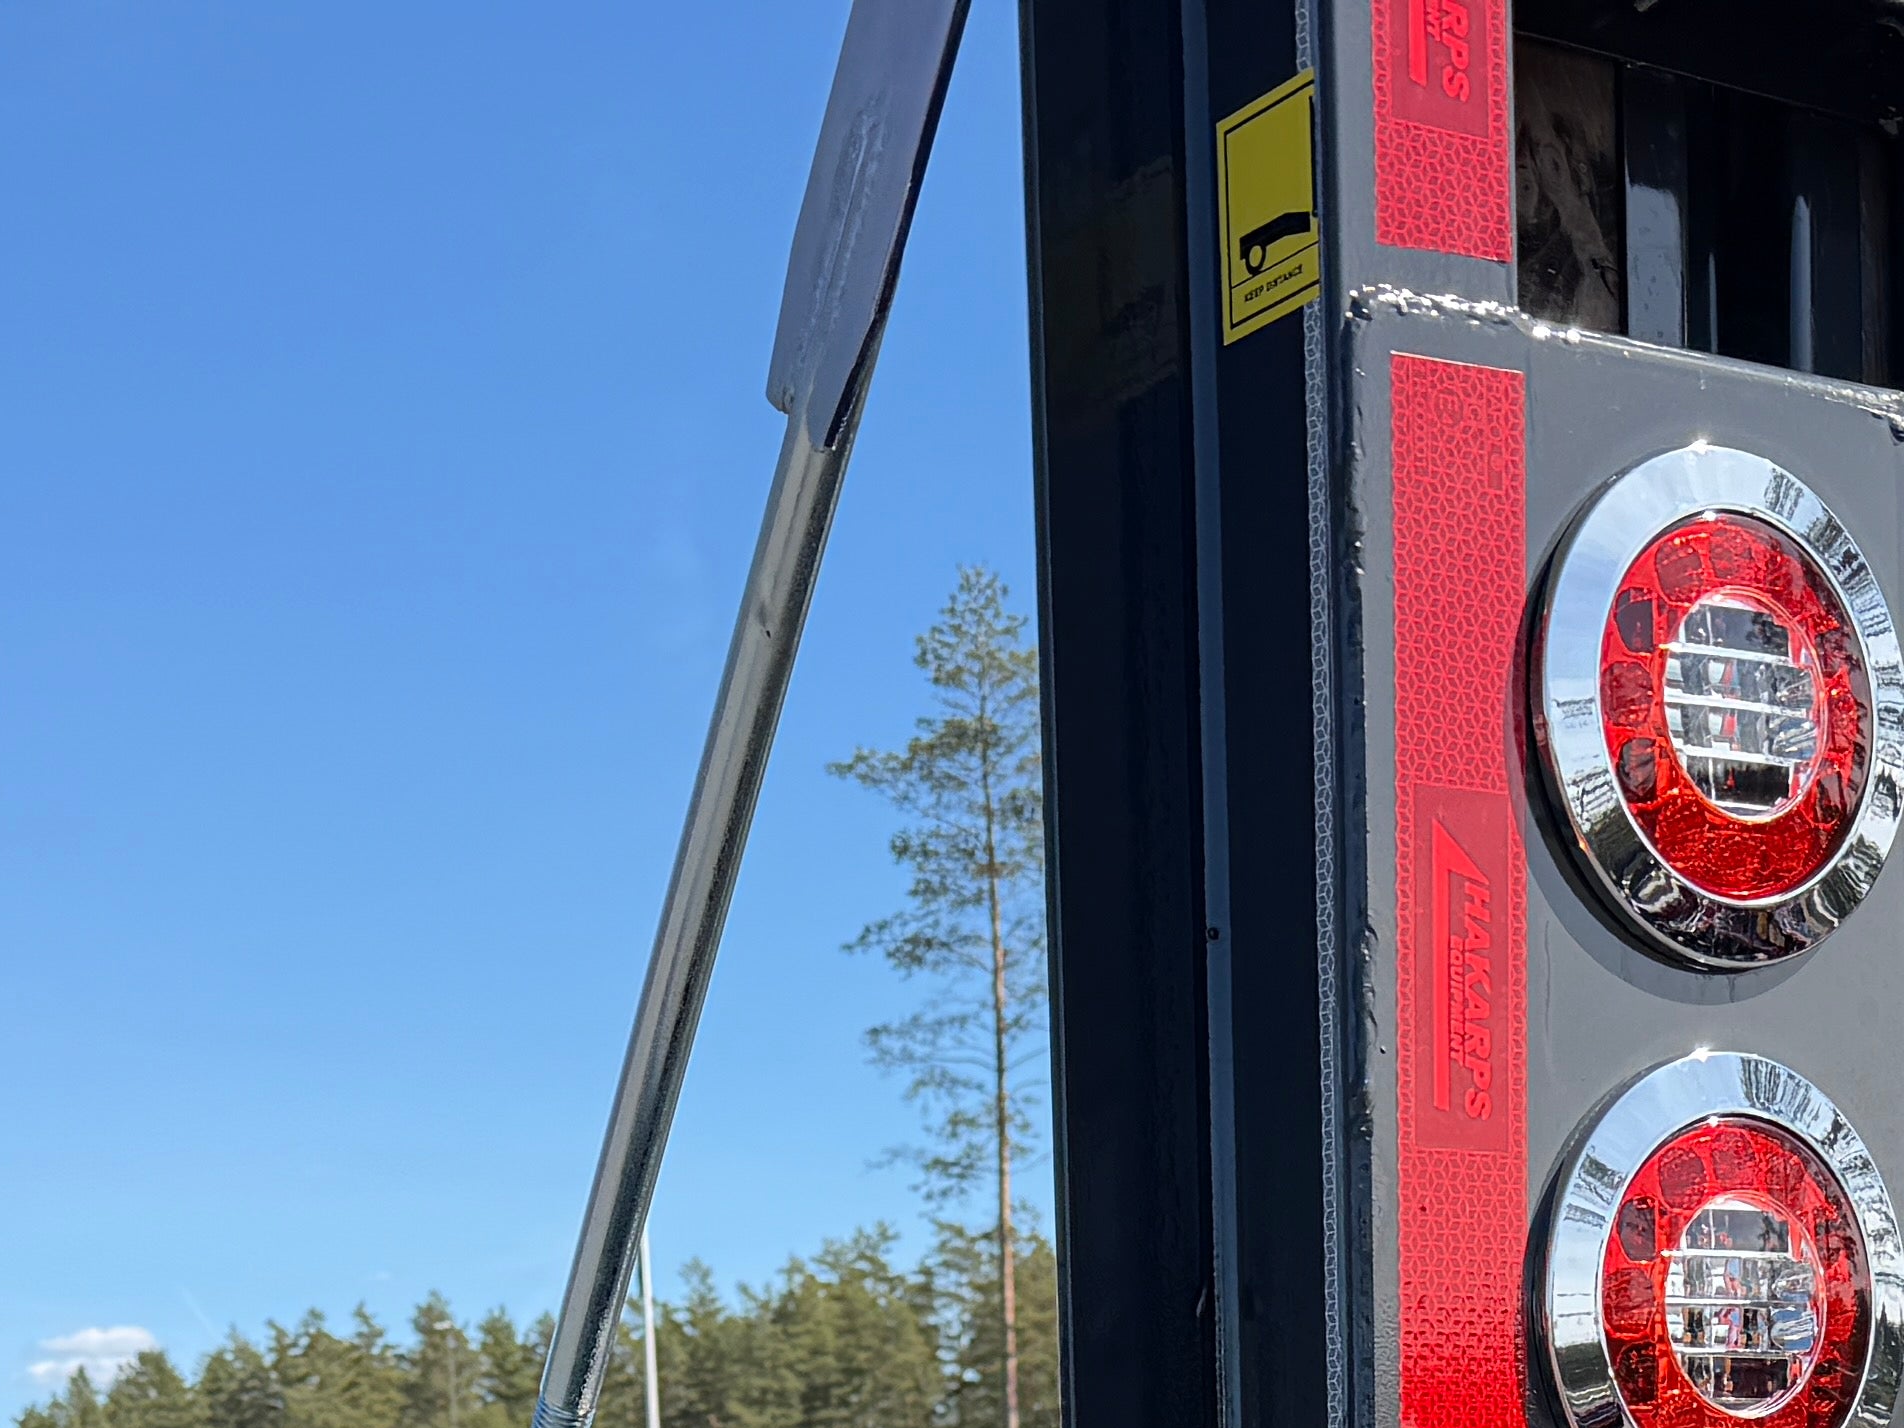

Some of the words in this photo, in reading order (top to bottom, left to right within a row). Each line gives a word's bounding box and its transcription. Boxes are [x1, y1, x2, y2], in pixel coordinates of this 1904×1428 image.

[1243, 283, 1265, 304] KEEP
[1448, 934, 1465, 1062] EQUIPMENT
[1463, 881, 1492, 1121] HAKARPS
